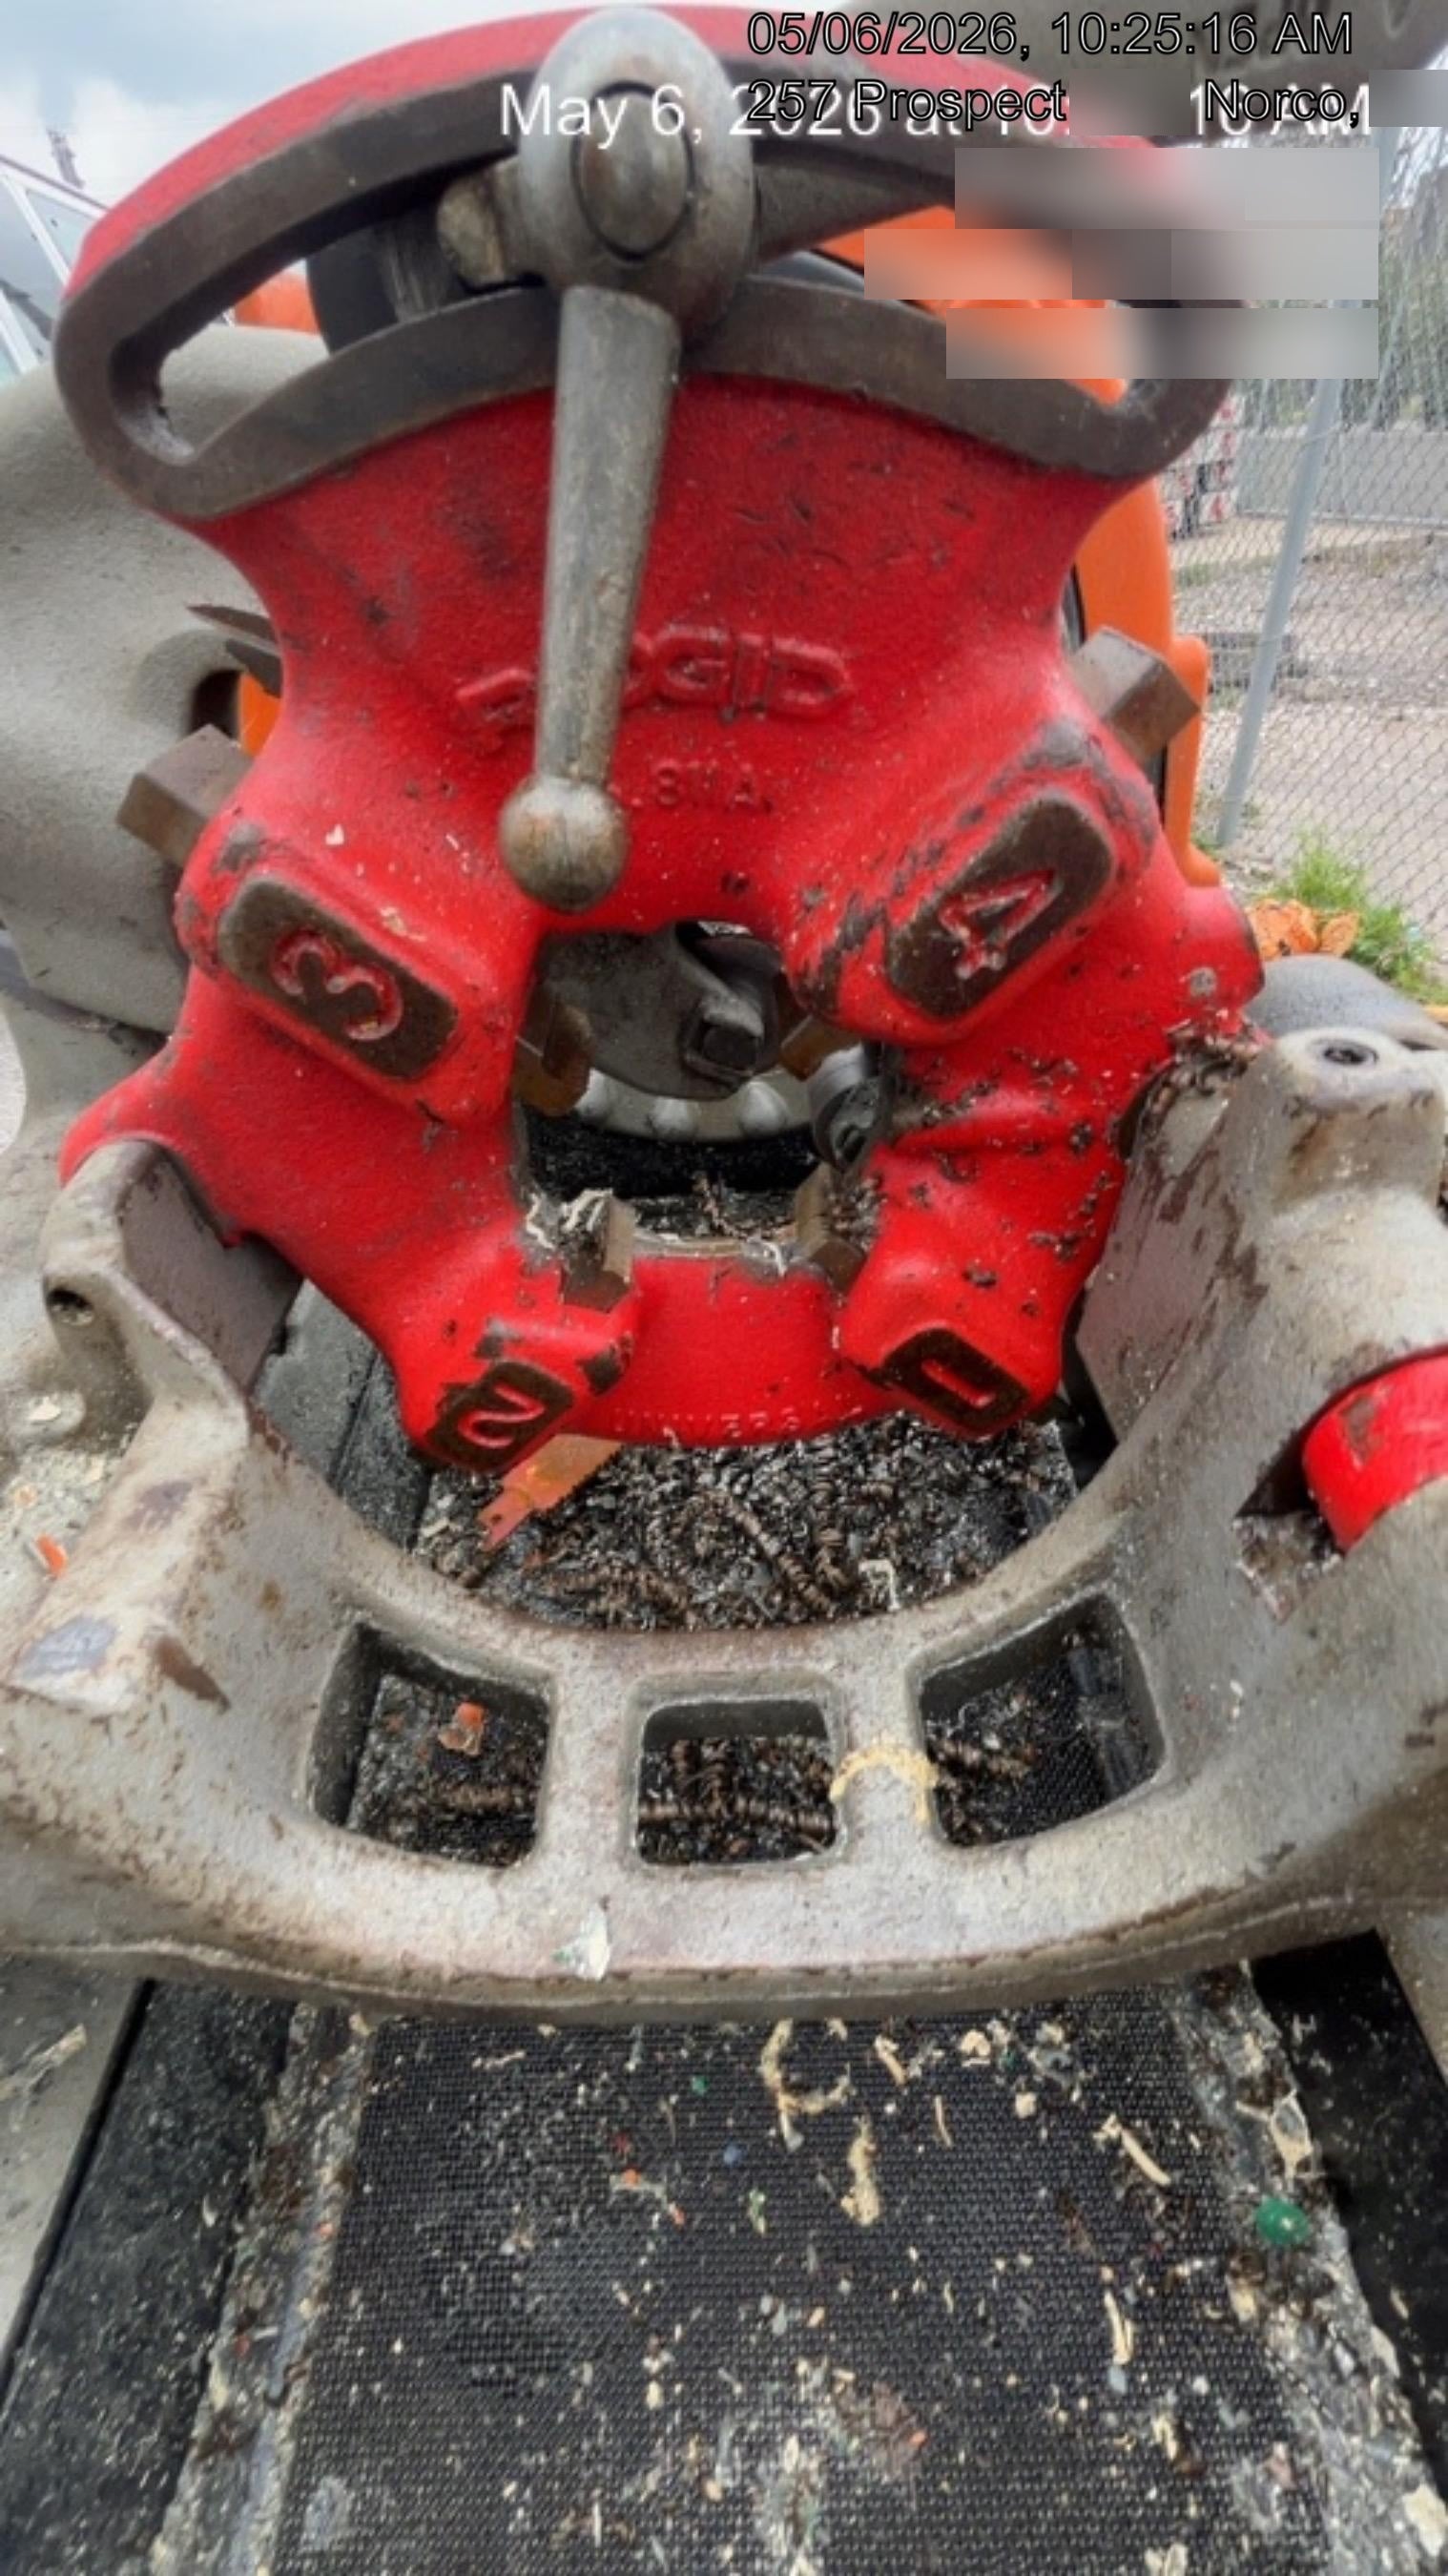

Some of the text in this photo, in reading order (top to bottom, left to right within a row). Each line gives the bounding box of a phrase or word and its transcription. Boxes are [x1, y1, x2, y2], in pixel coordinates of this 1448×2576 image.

[939, 870, 1061, 981] 4
[271, 929, 404, 1041] 3
[457, 1384, 546, 1449] 2
